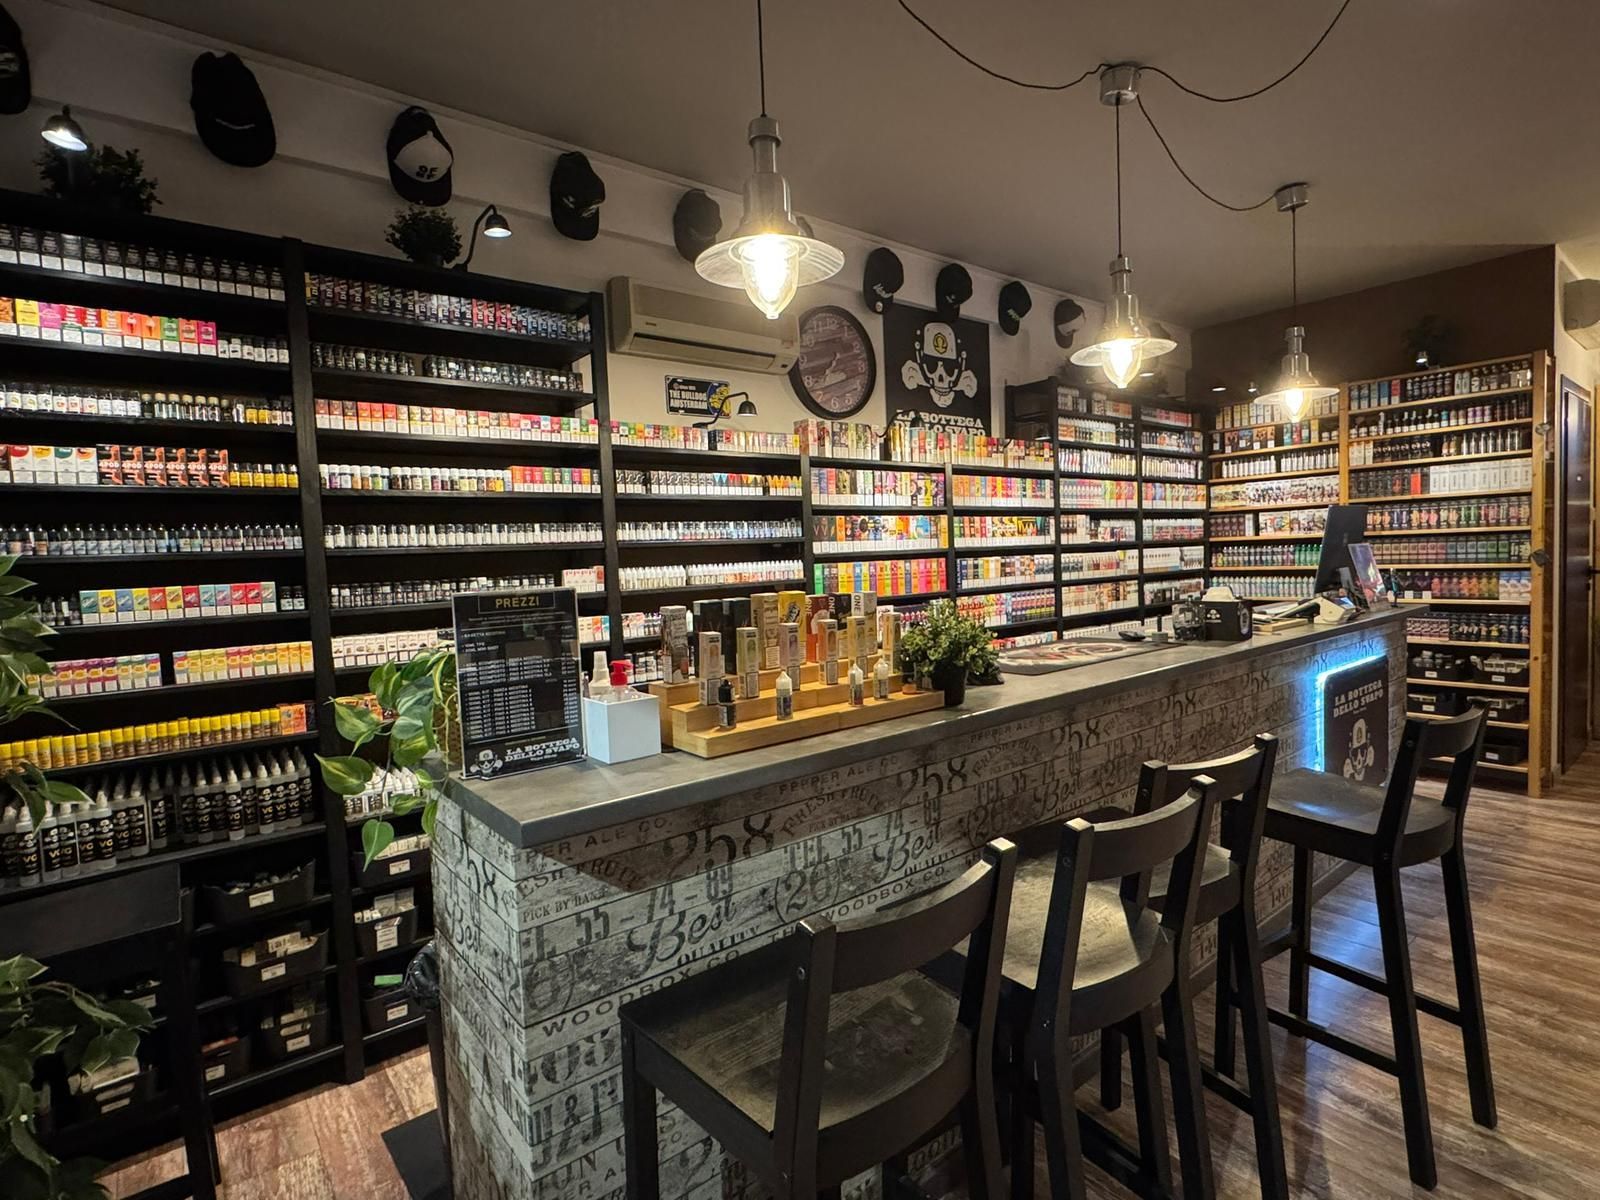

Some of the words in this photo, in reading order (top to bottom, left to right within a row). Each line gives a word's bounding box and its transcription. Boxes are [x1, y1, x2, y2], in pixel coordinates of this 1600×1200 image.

[813, 320, 822, 332] 11
[827, 318, 838, 330] 12
[844, 326, 849, 337] 1
[853, 342, 860, 352] 2
[858, 360, 865, 372] 3
[805, 375, 813, 387] 8
[670, 389, 681, 399] THE
[681, 391, 707, 401] BULLDOG
[670, 398, 708, 409] AMSTERDAM
[816, 391, 824, 402] 7
[831, 397, 839, 409] 6
[845, 393, 852, 405] 5
[920, 411, 984, 428] BOTTEGA
[495, 596, 540, 609] PREZZI
[828, 596, 836, 615] ONE
[1334, 693, 1346, 707] LA
[1347, 679, 1383, 701] BOTTEGA
[1158, 689, 1198, 722] 258
[1333, 699, 1360, 718] DELLO
[1360, 688, 1384, 706] SVAPO
[507, 747, 522, 756] LA
[524, 737, 578, 752] BOTTEGA
[1050, 717, 1101, 757] 258
[504, 749, 544, 762] DELLO
[544, 742, 580, 754] SVAPO
[896, 757, 969, 806] 258
[288, 800, 300, 809] VG
[100, 839, 114, 848] VG
[584, 828, 626, 850] ALE
[662, 811, 775, 884] 258
[783, 836, 830, 872] TEL
[872, 819, 942, 885] Best
[819, 873, 914, 922] WOODBOX
[522, 904, 552, 924] PICK
[553, 898, 572, 914] BY
[626, 893, 738, 976] Best
[541, 967, 692, 1028] WOODBOX
